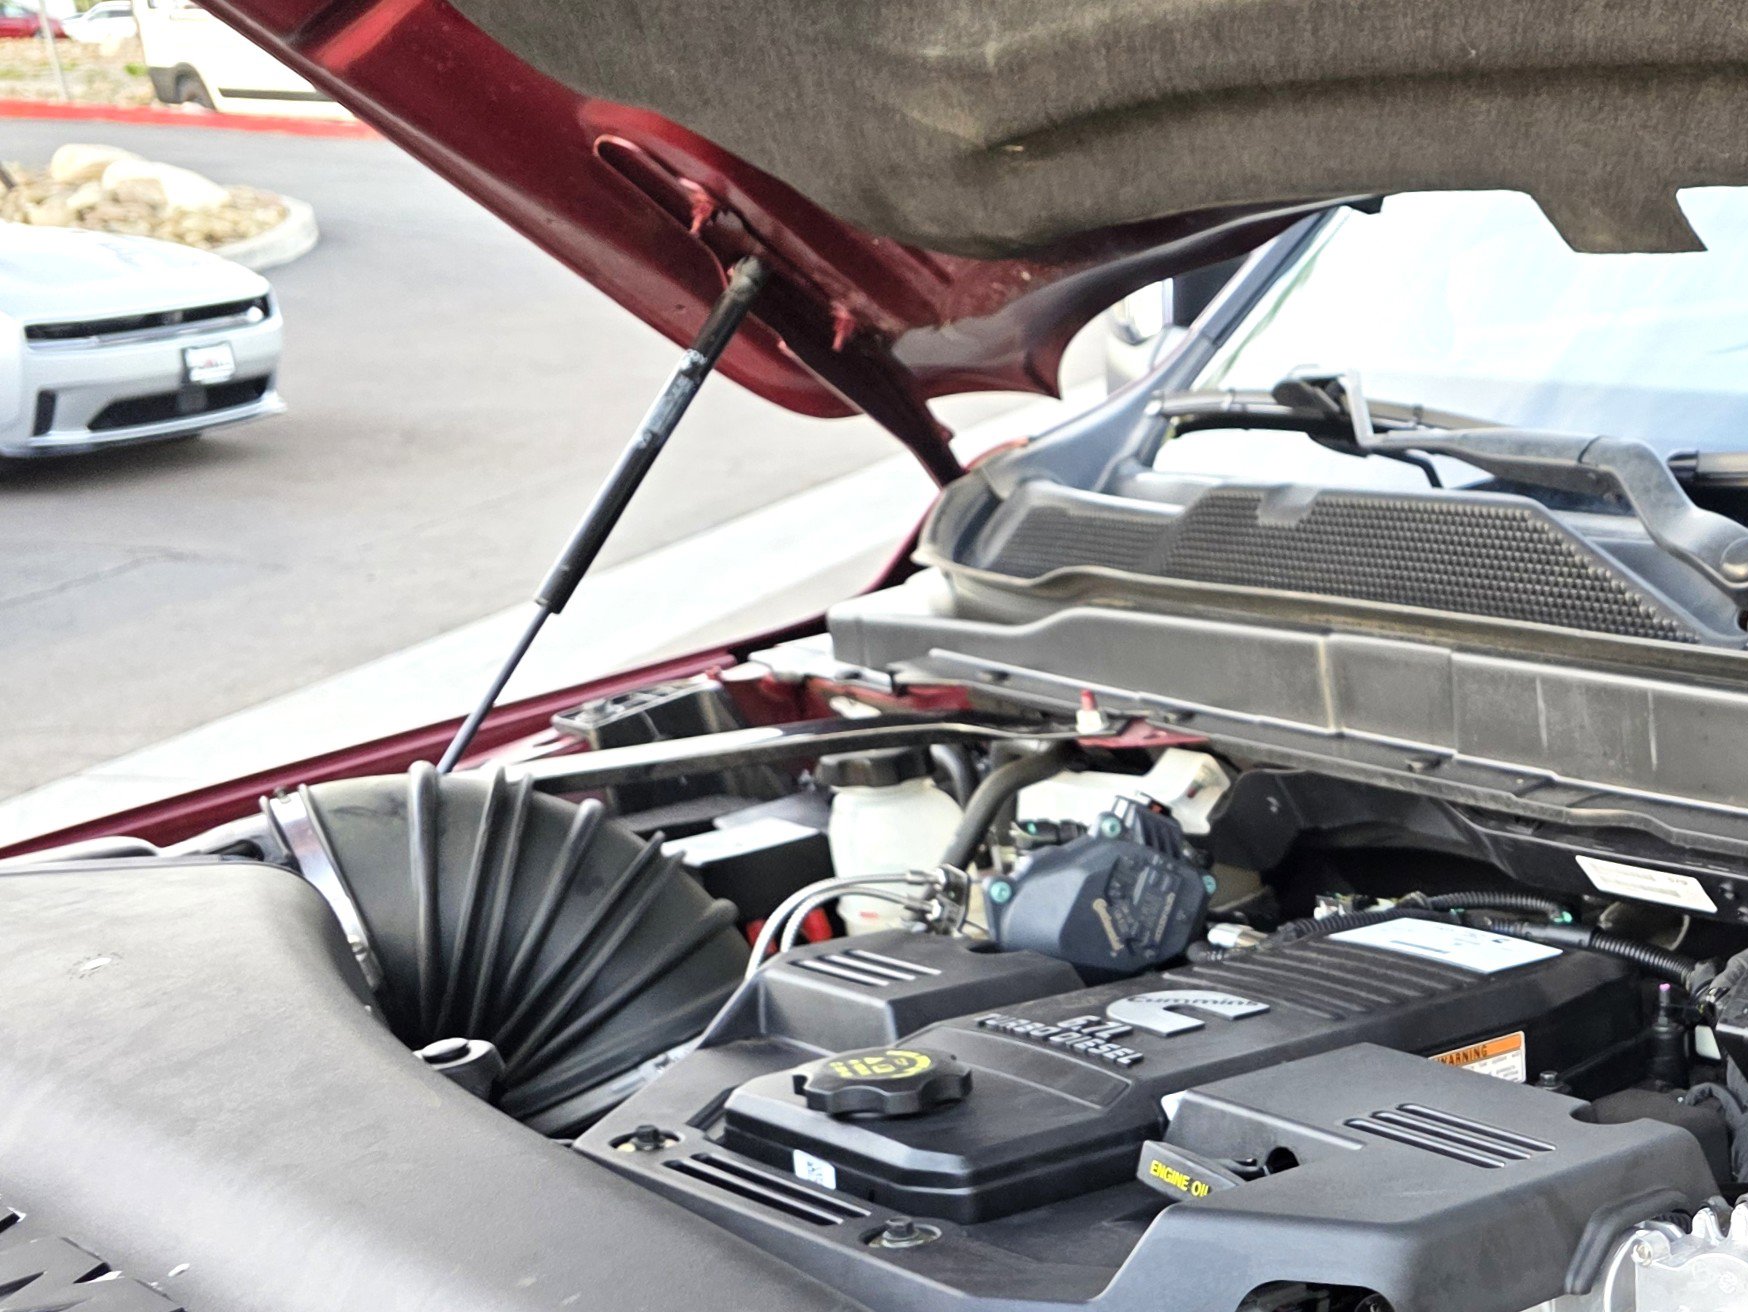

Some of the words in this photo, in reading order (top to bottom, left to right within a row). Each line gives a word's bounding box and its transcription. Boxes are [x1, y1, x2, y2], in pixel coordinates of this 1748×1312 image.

[973, 1012, 1062, 1038] TURBO
[1049, 1032, 1144, 1067] DIESEL
[1150, 1159, 1191, 1192] ENGINE
